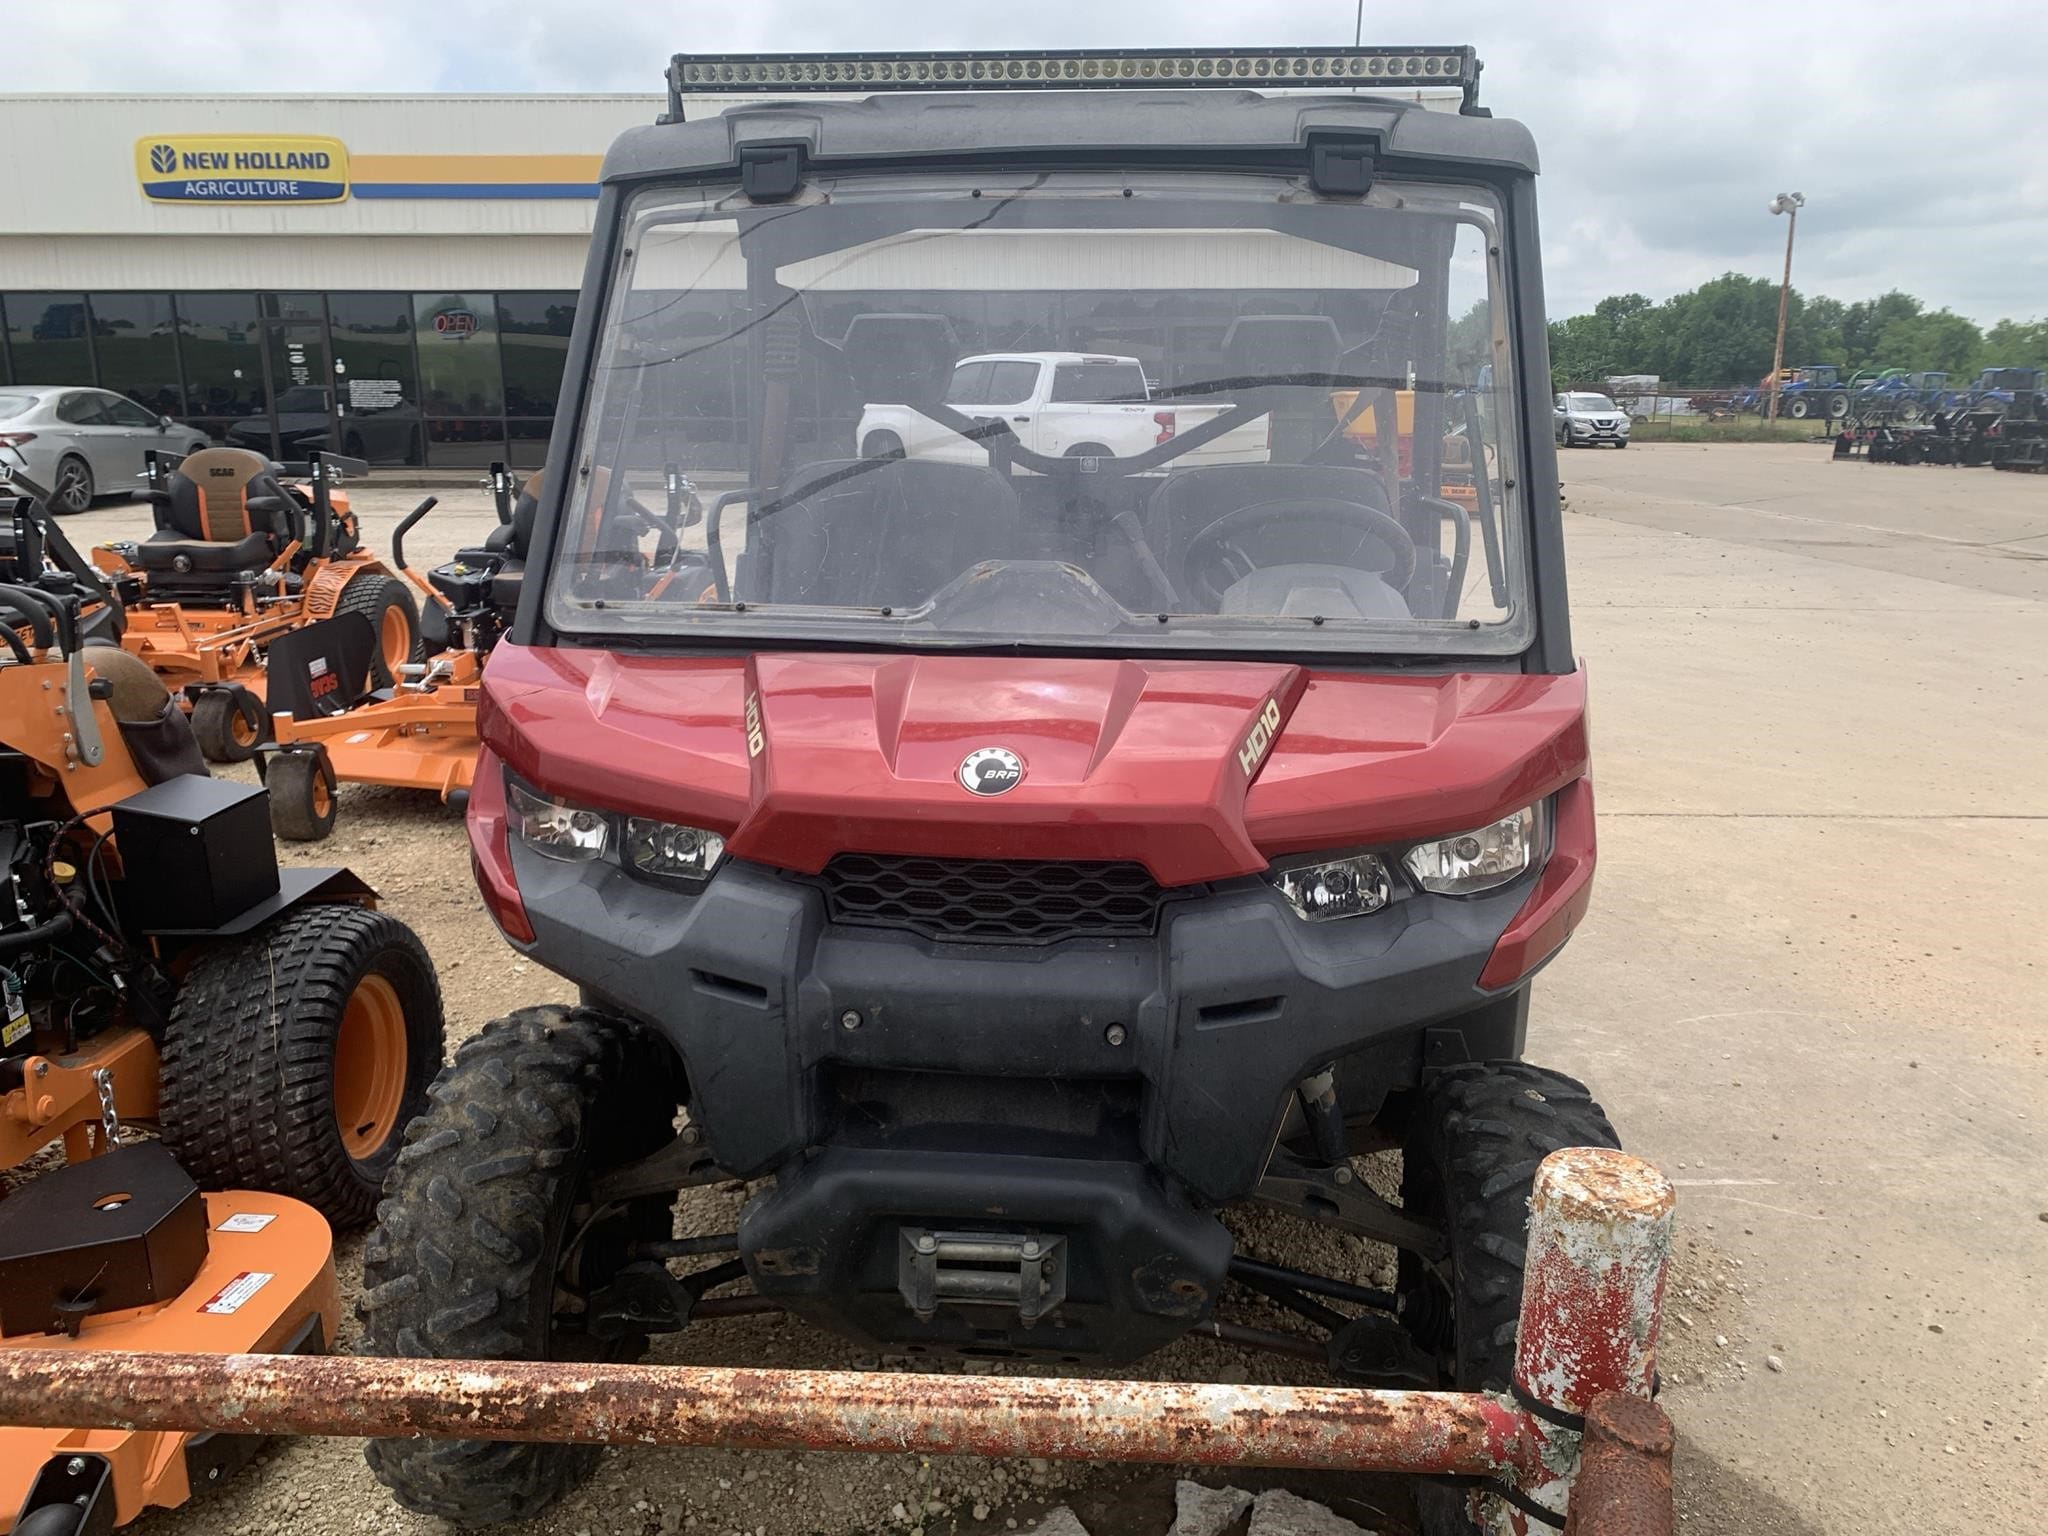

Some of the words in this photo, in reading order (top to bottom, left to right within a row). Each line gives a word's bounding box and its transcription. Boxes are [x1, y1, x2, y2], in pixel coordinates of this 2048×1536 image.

[183, 152, 229, 170] NEW
[234, 152, 330, 170] HOLLAND
[184, 181, 299, 196] AGRICULTURE
[435, 315, 476, 335] OPEN
[209, 468, 235, 478] SCAG
[745, 690, 764, 758] HD10
[1238, 698, 1281, 777] HD10
[983, 769, 1020, 780] BRP
